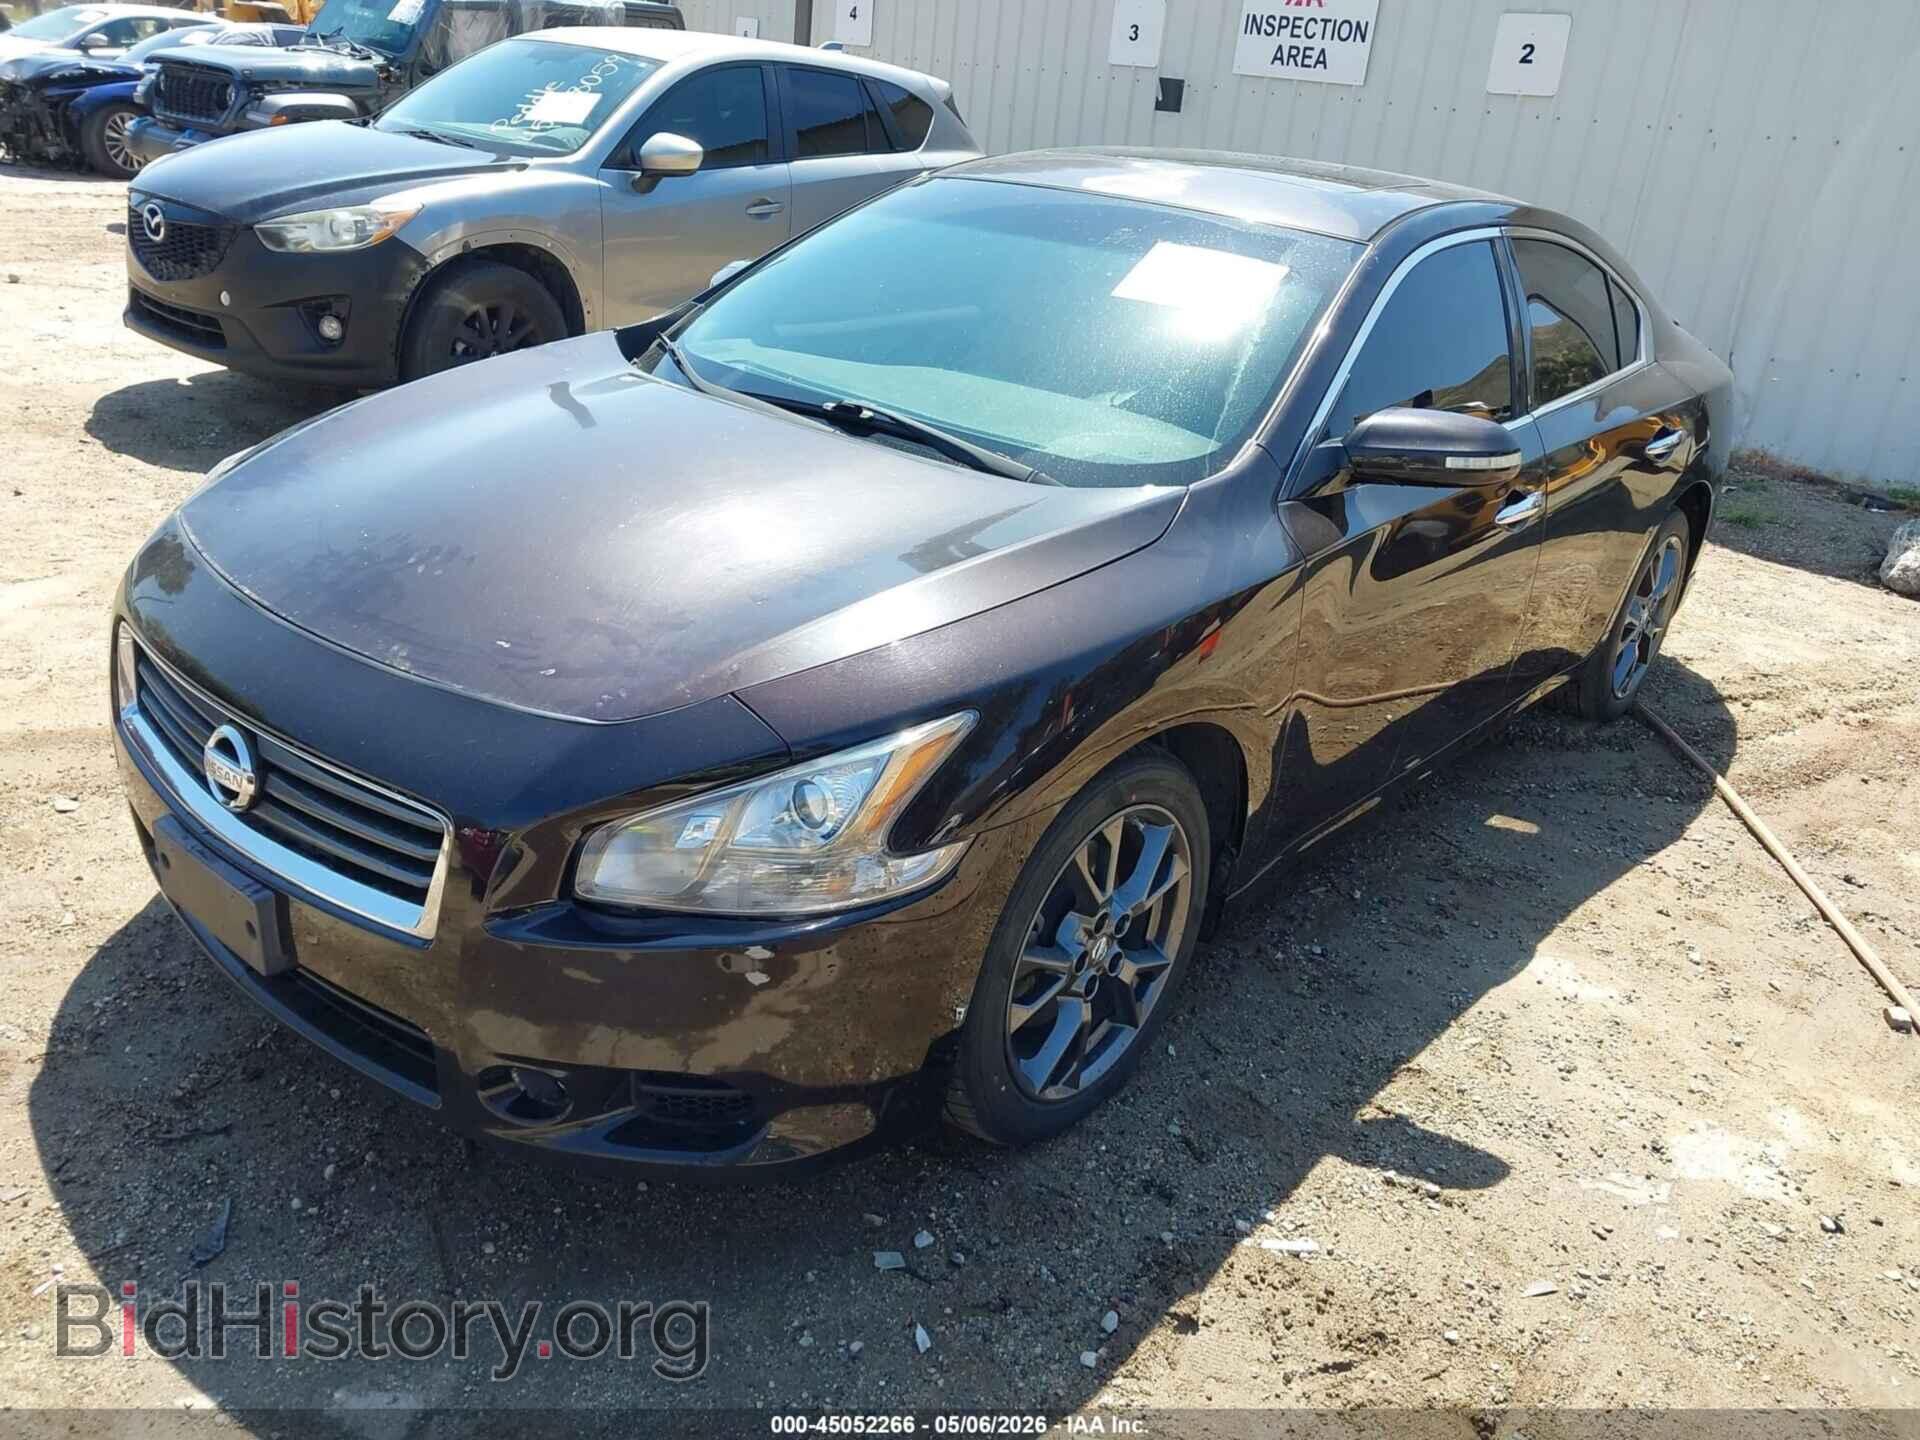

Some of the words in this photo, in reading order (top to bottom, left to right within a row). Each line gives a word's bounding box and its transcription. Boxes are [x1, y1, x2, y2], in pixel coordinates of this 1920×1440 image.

[849, 5, 857, 21] 4
[1128, 23, 1139, 42] 3
[1243, 12, 1369, 43] INSPECTION
[1270, 43, 1328, 70] AREA
[1518, 42, 1536, 65] 2
